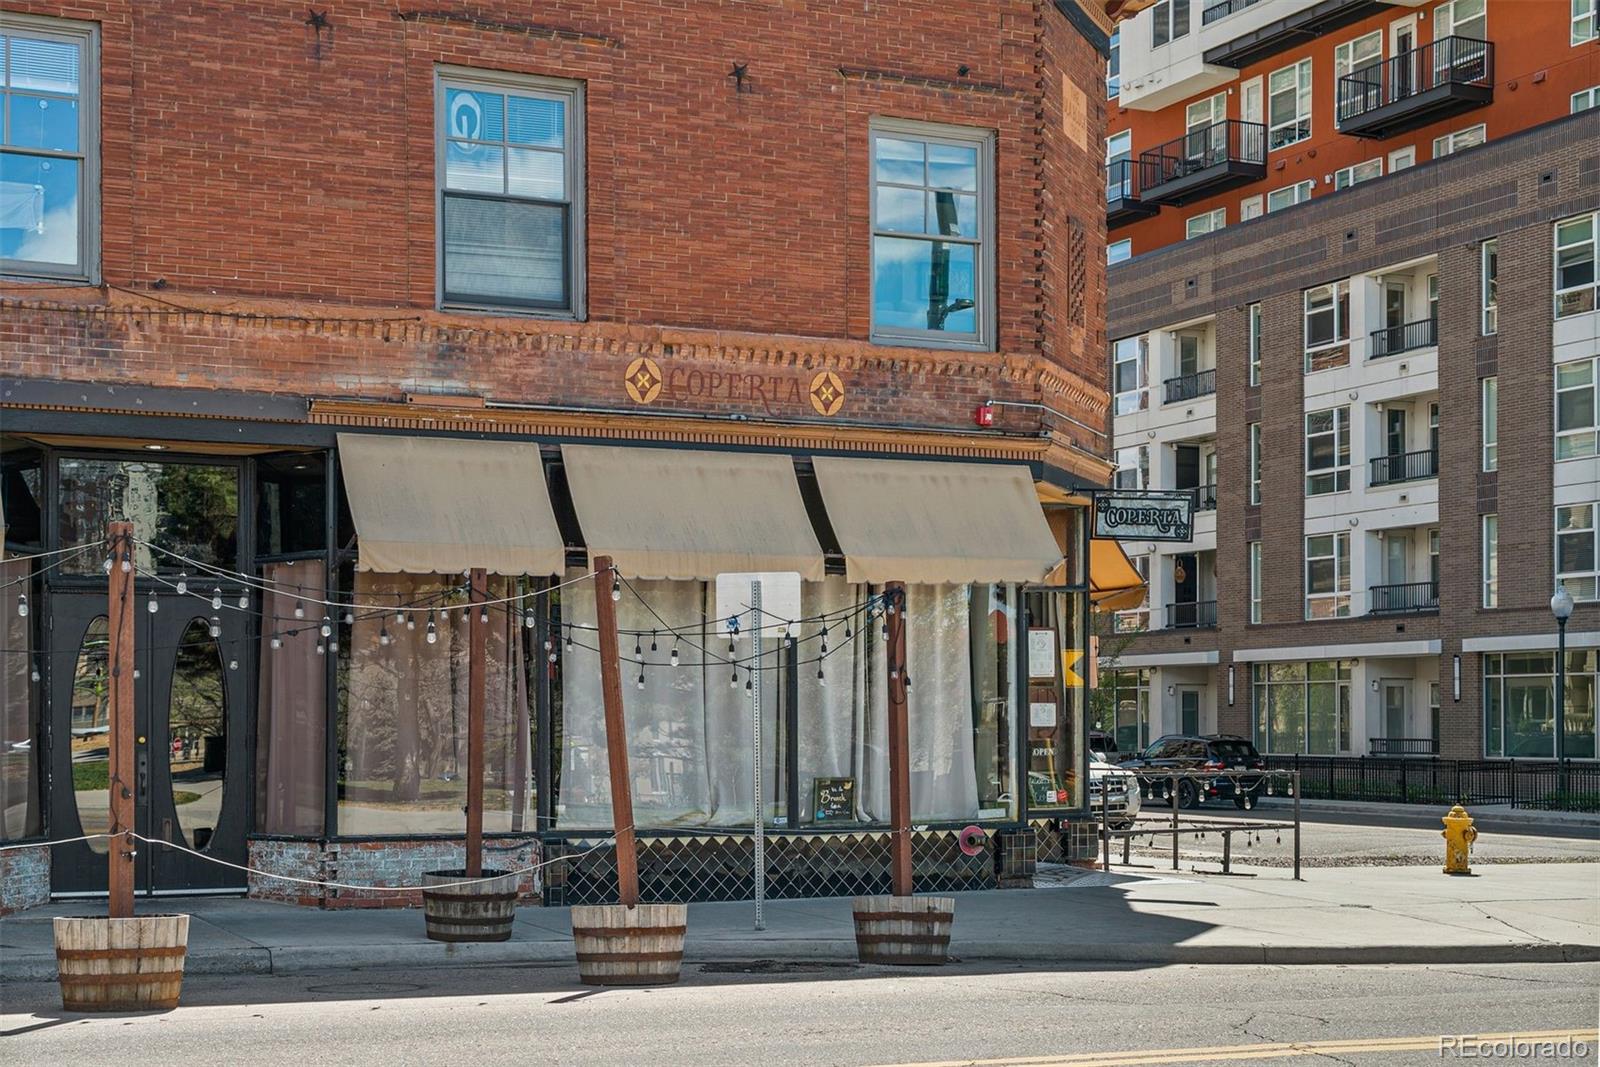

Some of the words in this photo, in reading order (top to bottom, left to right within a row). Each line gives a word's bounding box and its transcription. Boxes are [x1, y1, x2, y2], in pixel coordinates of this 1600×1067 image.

[668, 367, 803, 417] COPERTA
[1105, 506, 1182, 533] COPERTA
[1032, 748, 1055, 757] OPEN
